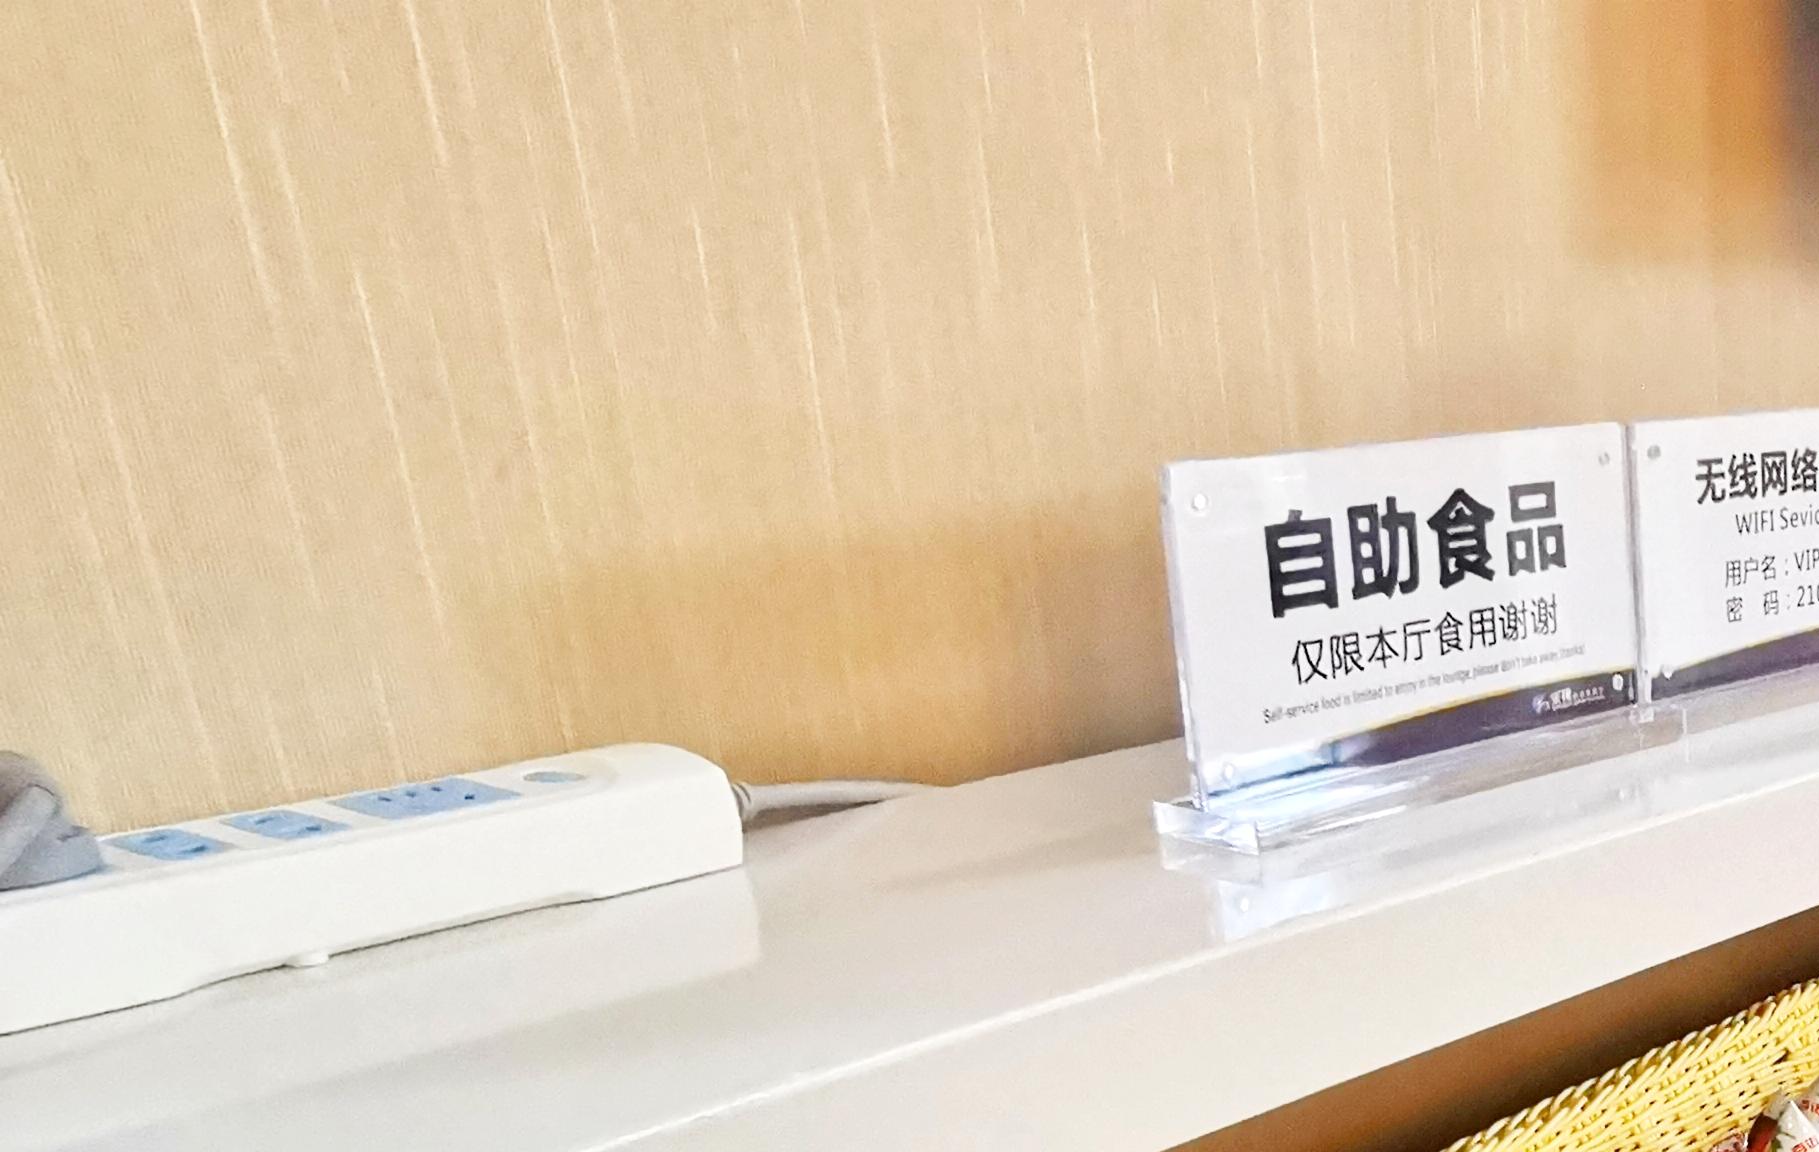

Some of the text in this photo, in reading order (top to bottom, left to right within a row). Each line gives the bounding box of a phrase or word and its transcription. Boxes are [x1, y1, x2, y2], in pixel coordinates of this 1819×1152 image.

[1264, 481, 1567, 618] 自助食品
[1736, 509, 1775, 536] WIFI
[1291, 594, 1557, 685] 仅限本厅食用谢谢
